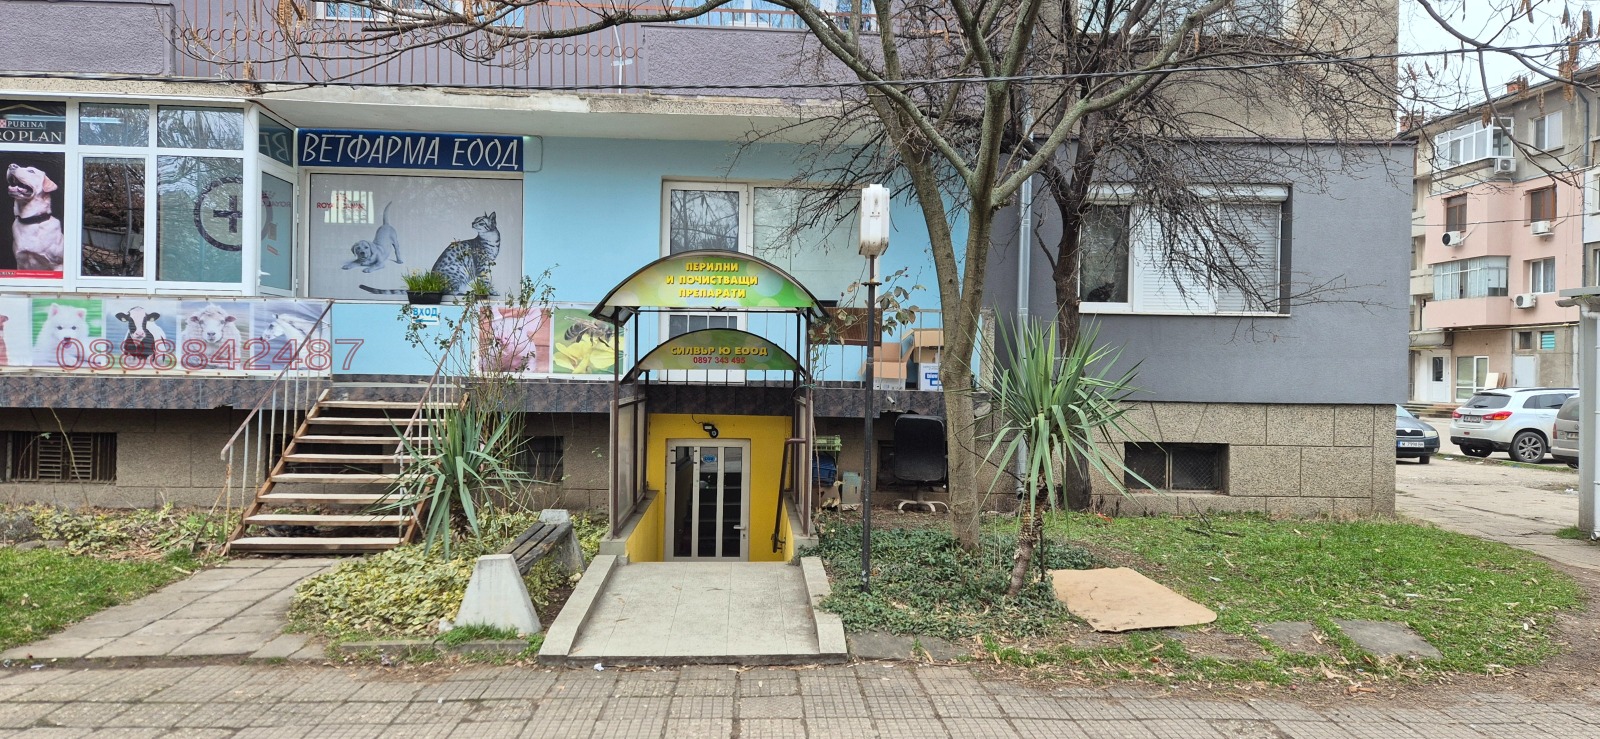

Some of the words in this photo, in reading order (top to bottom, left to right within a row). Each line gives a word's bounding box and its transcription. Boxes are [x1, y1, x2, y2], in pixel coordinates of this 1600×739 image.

[7, 120, 44, 128] PURINA
[18, 130, 62, 142] PLAN
[302, 132, 440, 166] ВЕТФАРМА
[451, 138, 519, 170] ЕООД
[685, 262, 739, 272] ПЕРИЛНИ
[666, 275, 674, 285] И
[679, 275, 758, 287] ПОЧИСТВАЩИ
[679, 289, 746, 298] ПРЕПАРАТИ
[413, 307, 437, 317] ВХОД
[56, 338, 364, 371] 0888842487
[719, 346, 731, 355] Ю
[735, 346, 768, 356] ЕООД
[693, 356, 712, 364] 0897
[715, 356, 729, 364] 343
[731, 356, 746, 364] 495
